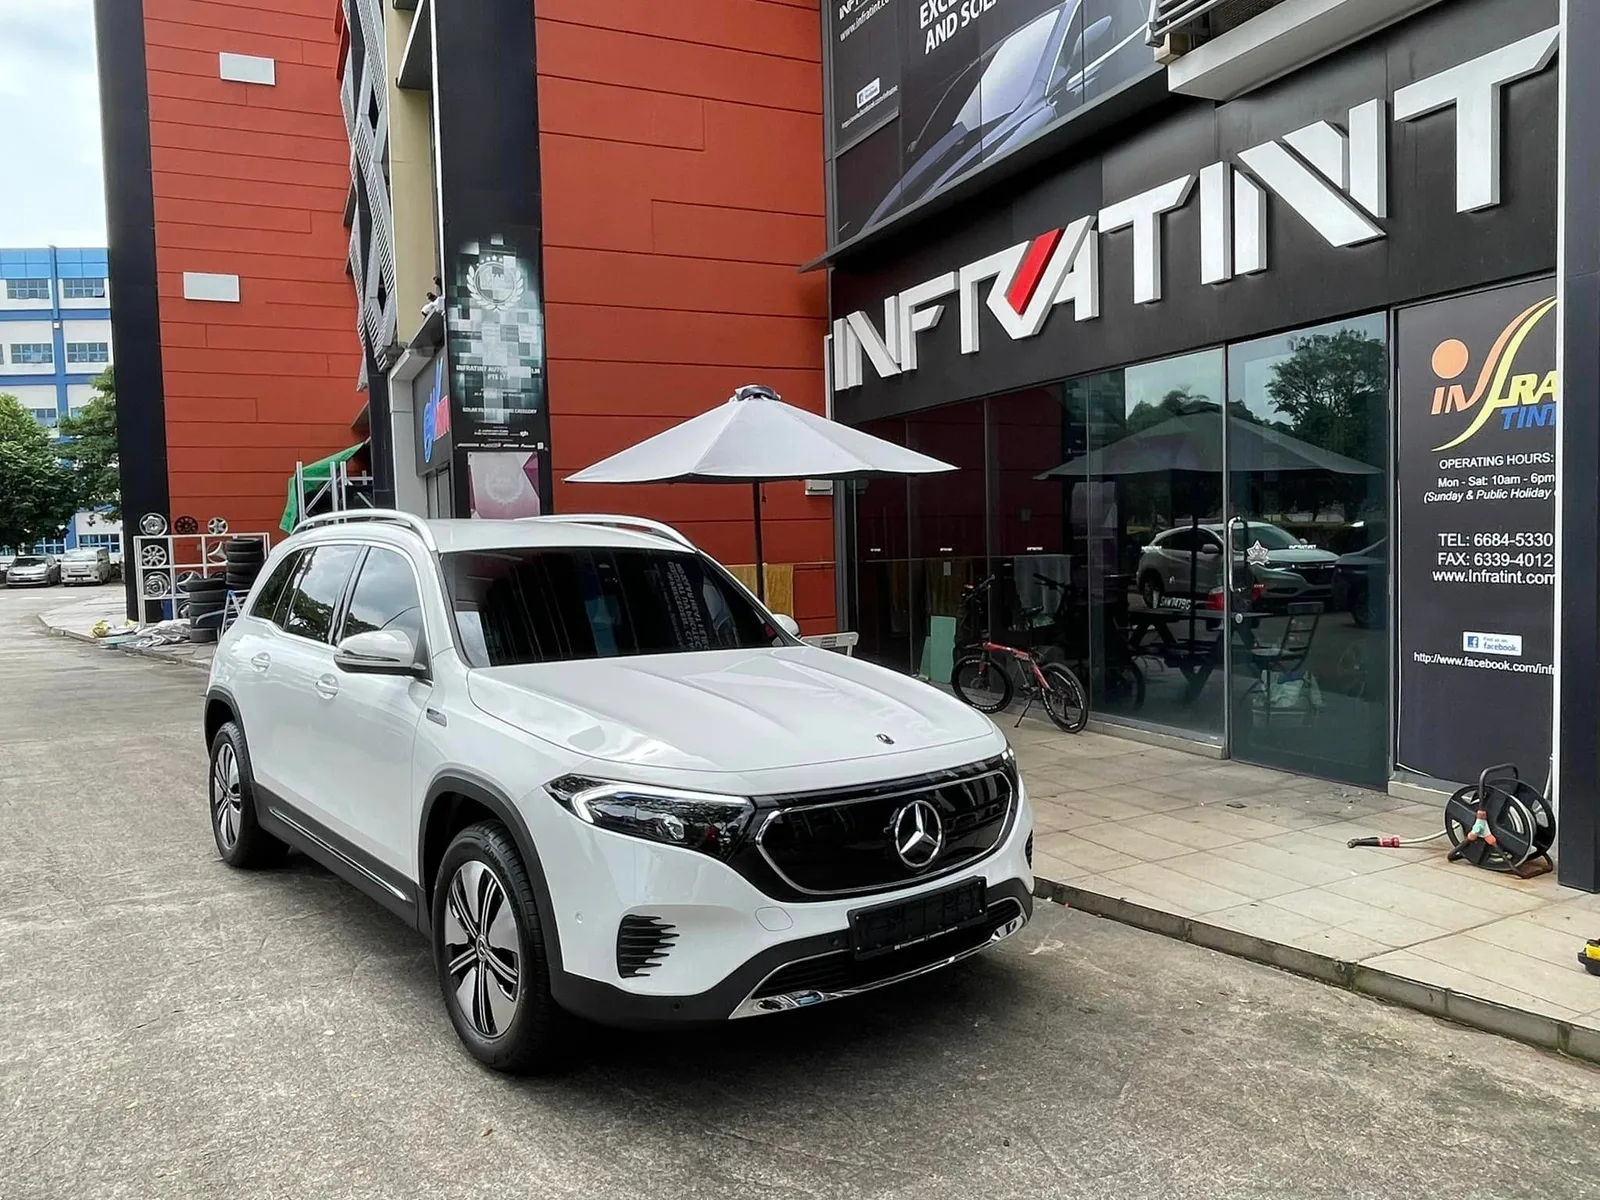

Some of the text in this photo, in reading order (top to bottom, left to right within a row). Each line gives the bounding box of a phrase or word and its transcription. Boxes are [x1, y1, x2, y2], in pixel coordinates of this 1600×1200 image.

[925, 12, 958, 55] AND
[833, 23, 1559, 392] INFRATINT
[1439, 452, 1554, 470] OPERATING HOURS:
[1437, 478, 1459, 488] Mon
[1468, 475, 1488, 487] Sat:
[1492, 474, 1521, 486] 10am
[1530, 473, 1555, 486] 6pm
[1424, 491, 1464, 504] (Sunday
[1466, 490, 1474, 500] &
[1476, 489, 1508, 500] Public
[1510, 487, 1552, 500] Holiday
[1438, 532, 1554, 547] TEL: 6684-5330
[1438, 552, 1554, 568] FAX: 6339-4012
